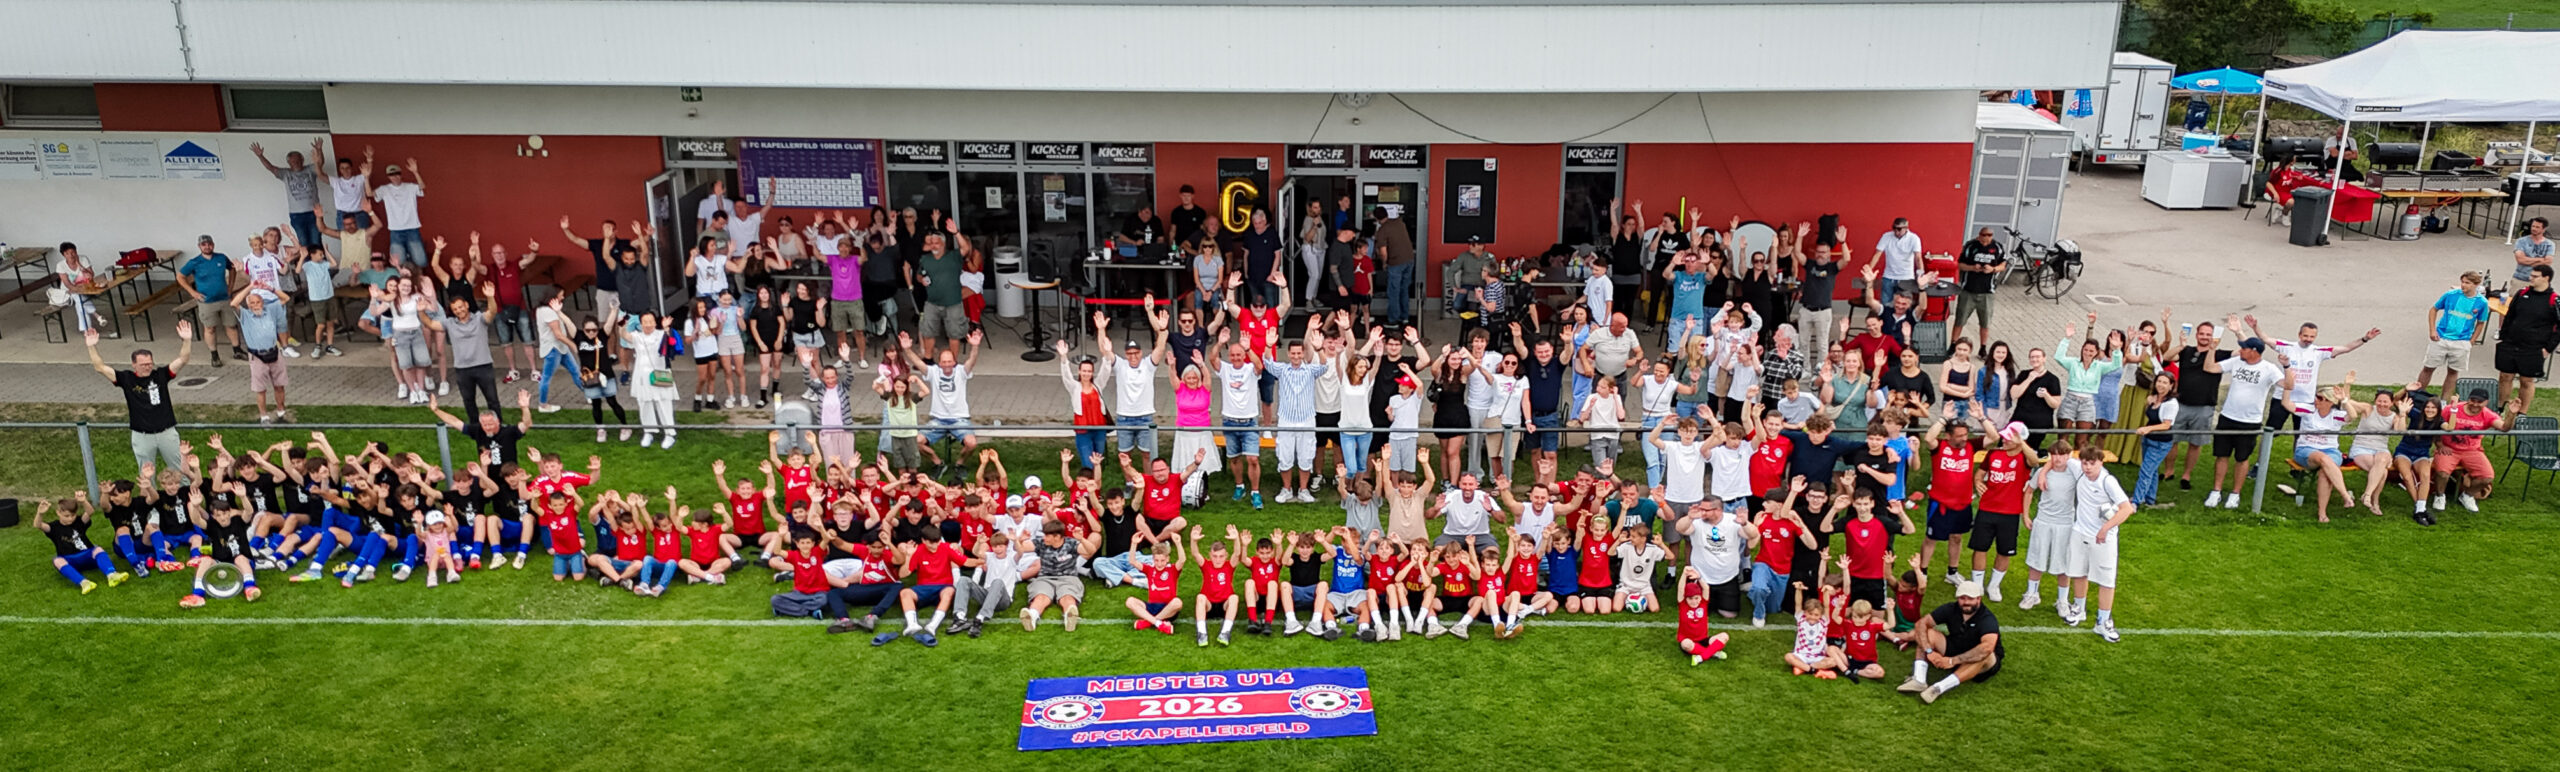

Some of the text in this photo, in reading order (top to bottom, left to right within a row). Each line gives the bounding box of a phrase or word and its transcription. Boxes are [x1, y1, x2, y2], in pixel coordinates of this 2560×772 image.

[42, 143, 57, 154] SG
[2233, 374, 2260, 385] JONES
[1087, 672, 1295, 694] MEISTER U14
[1138, 696, 1244, 717] 2026
[1071, 722, 1310, 744] #FCKAPELLERFELD
